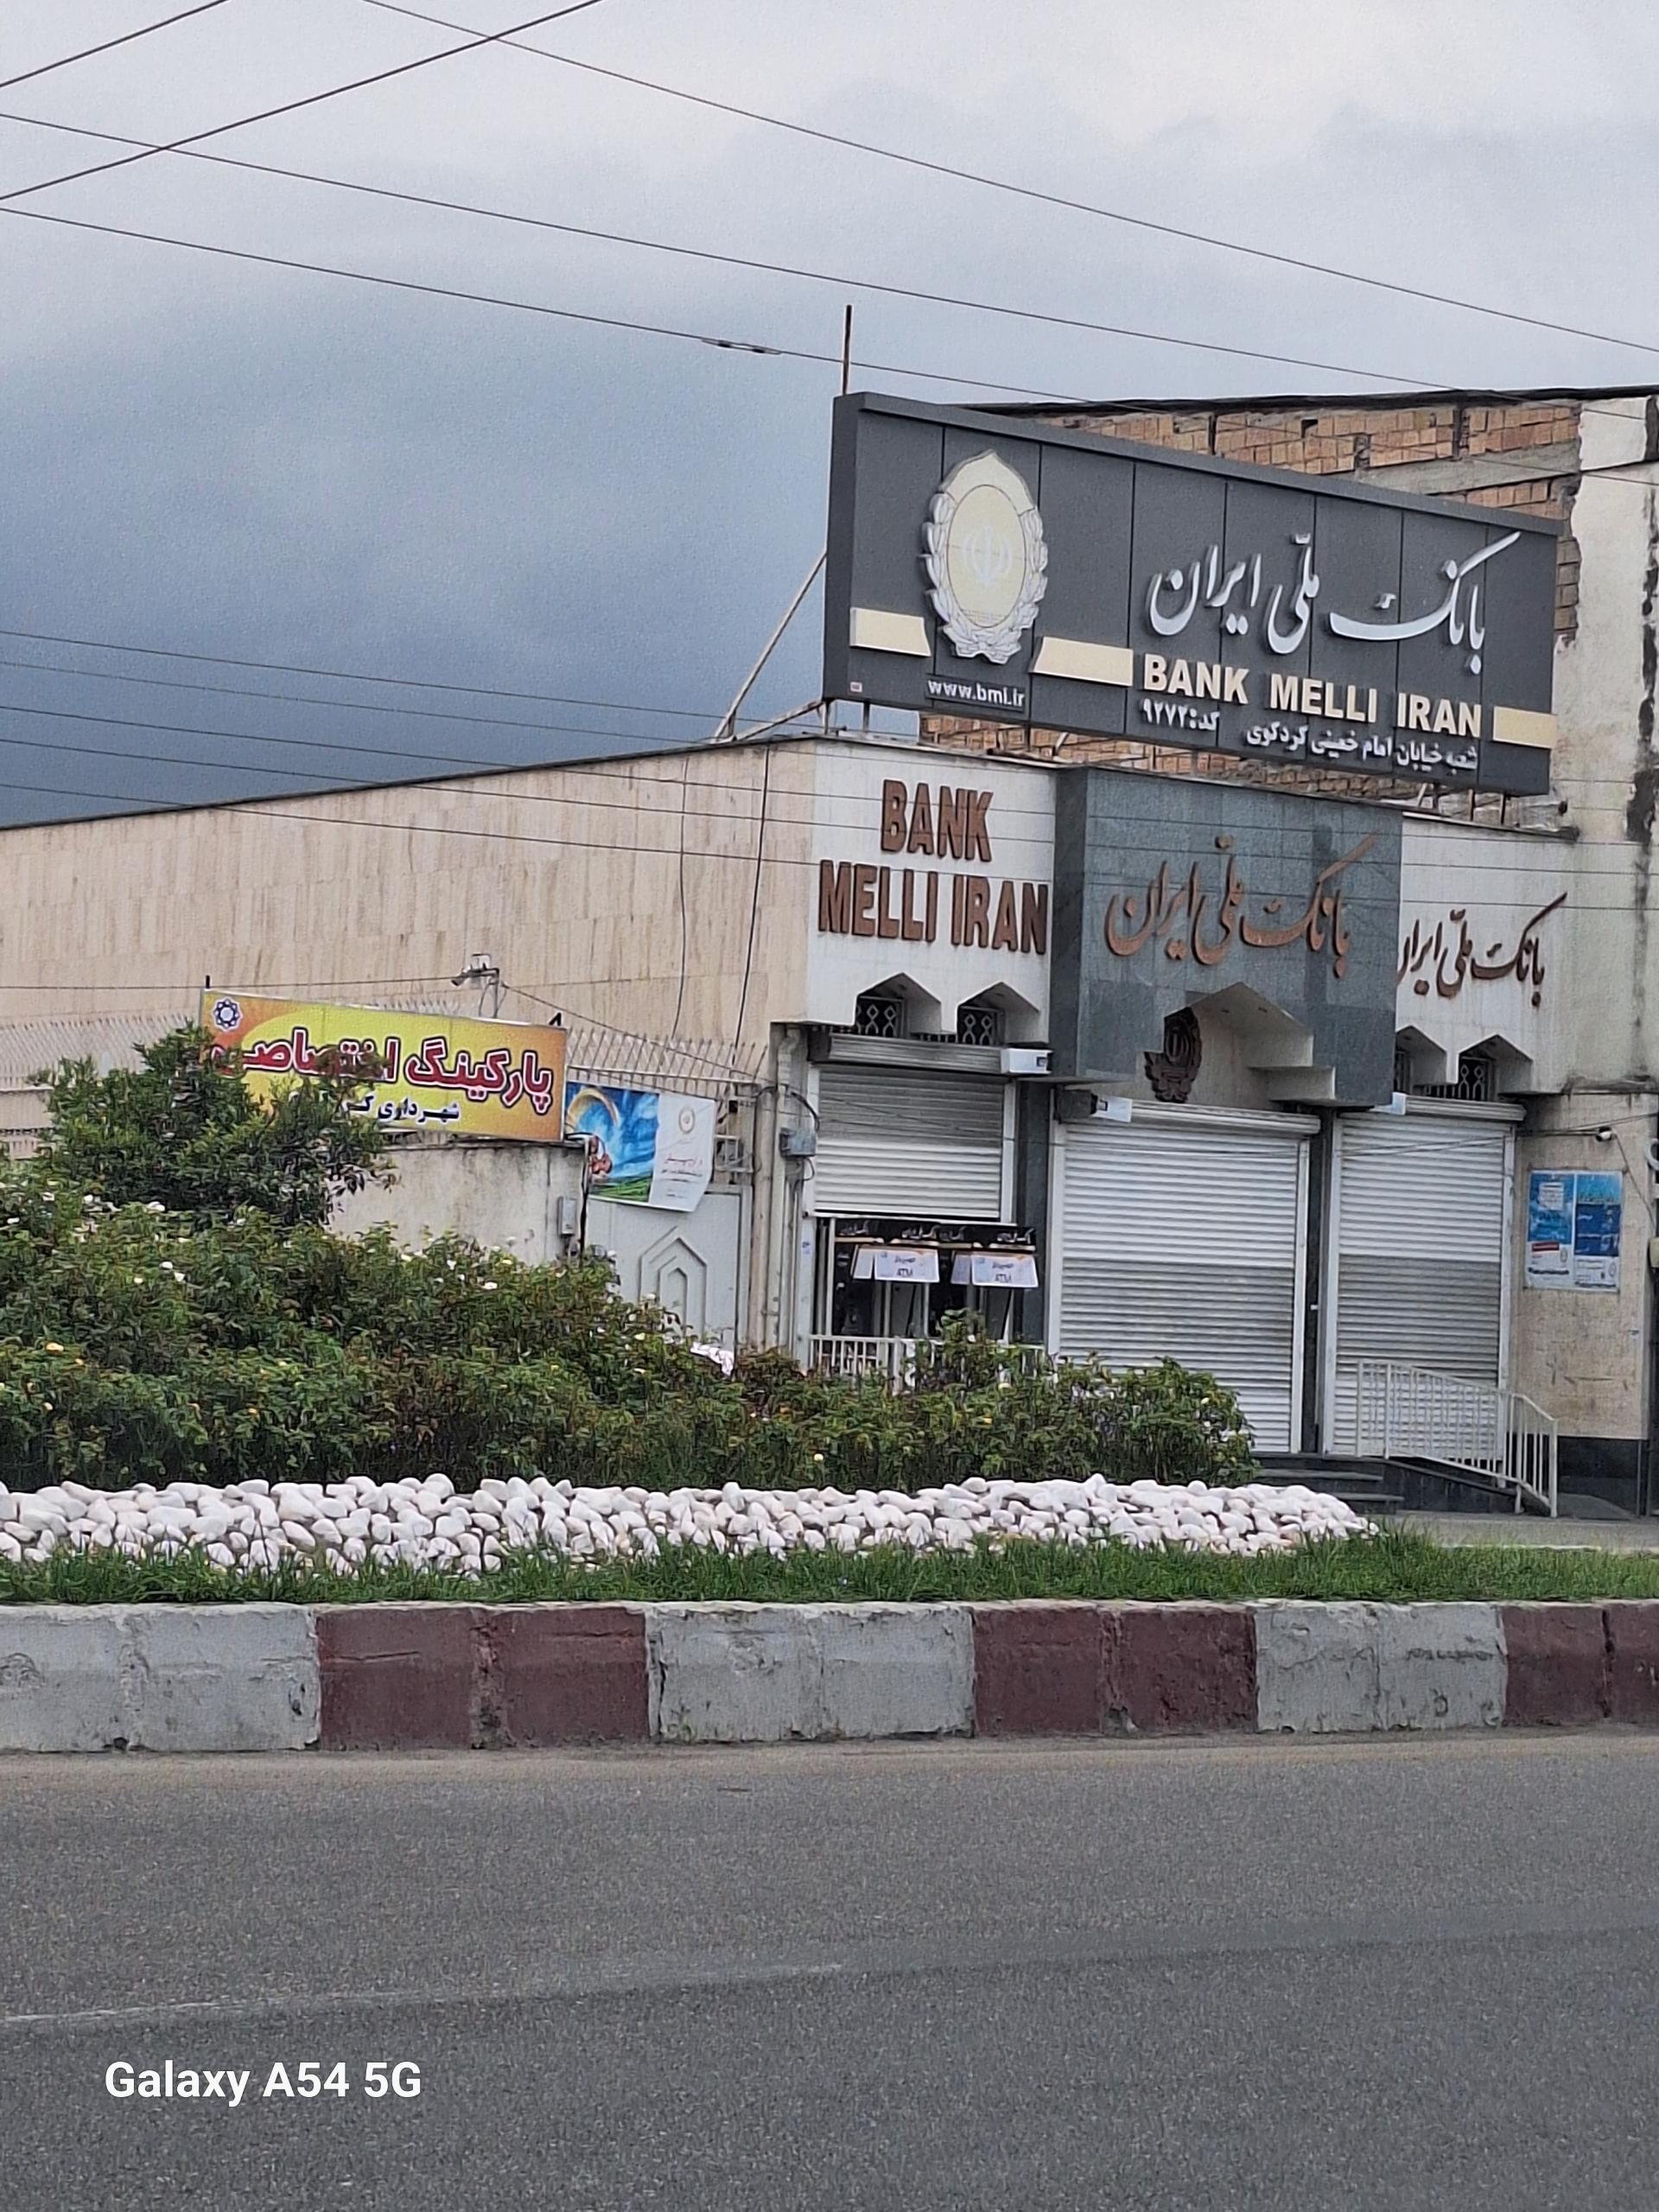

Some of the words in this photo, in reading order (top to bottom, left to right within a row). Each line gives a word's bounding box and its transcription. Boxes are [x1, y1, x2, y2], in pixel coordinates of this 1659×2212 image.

[1148, 543, 1262, 636] ایران
[1329, 531, 1521, 674] بانک
[1144, 653, 1249, 704] BANK
[1270, 673, 1378, 723] MELLI
[1397, 692, 1481, 739] IRAN
[1362, 734, 1393, 760] امام
[1396, 739, 1443, 771] خیابان
[880, 779, 994, 862] BANK
[818, 859, 938, 943] MELLI
[951, 874, 1048, 955] IRAN
[1106, 860, 1200, 961] ایران
[1240, 831, 1379, 980] بانک
[1471, 892, 1567, 1007] بانک
[378, 1096, 461, 1124] شهرداری
[405, 1036, 554, 1116] پارکینگ
